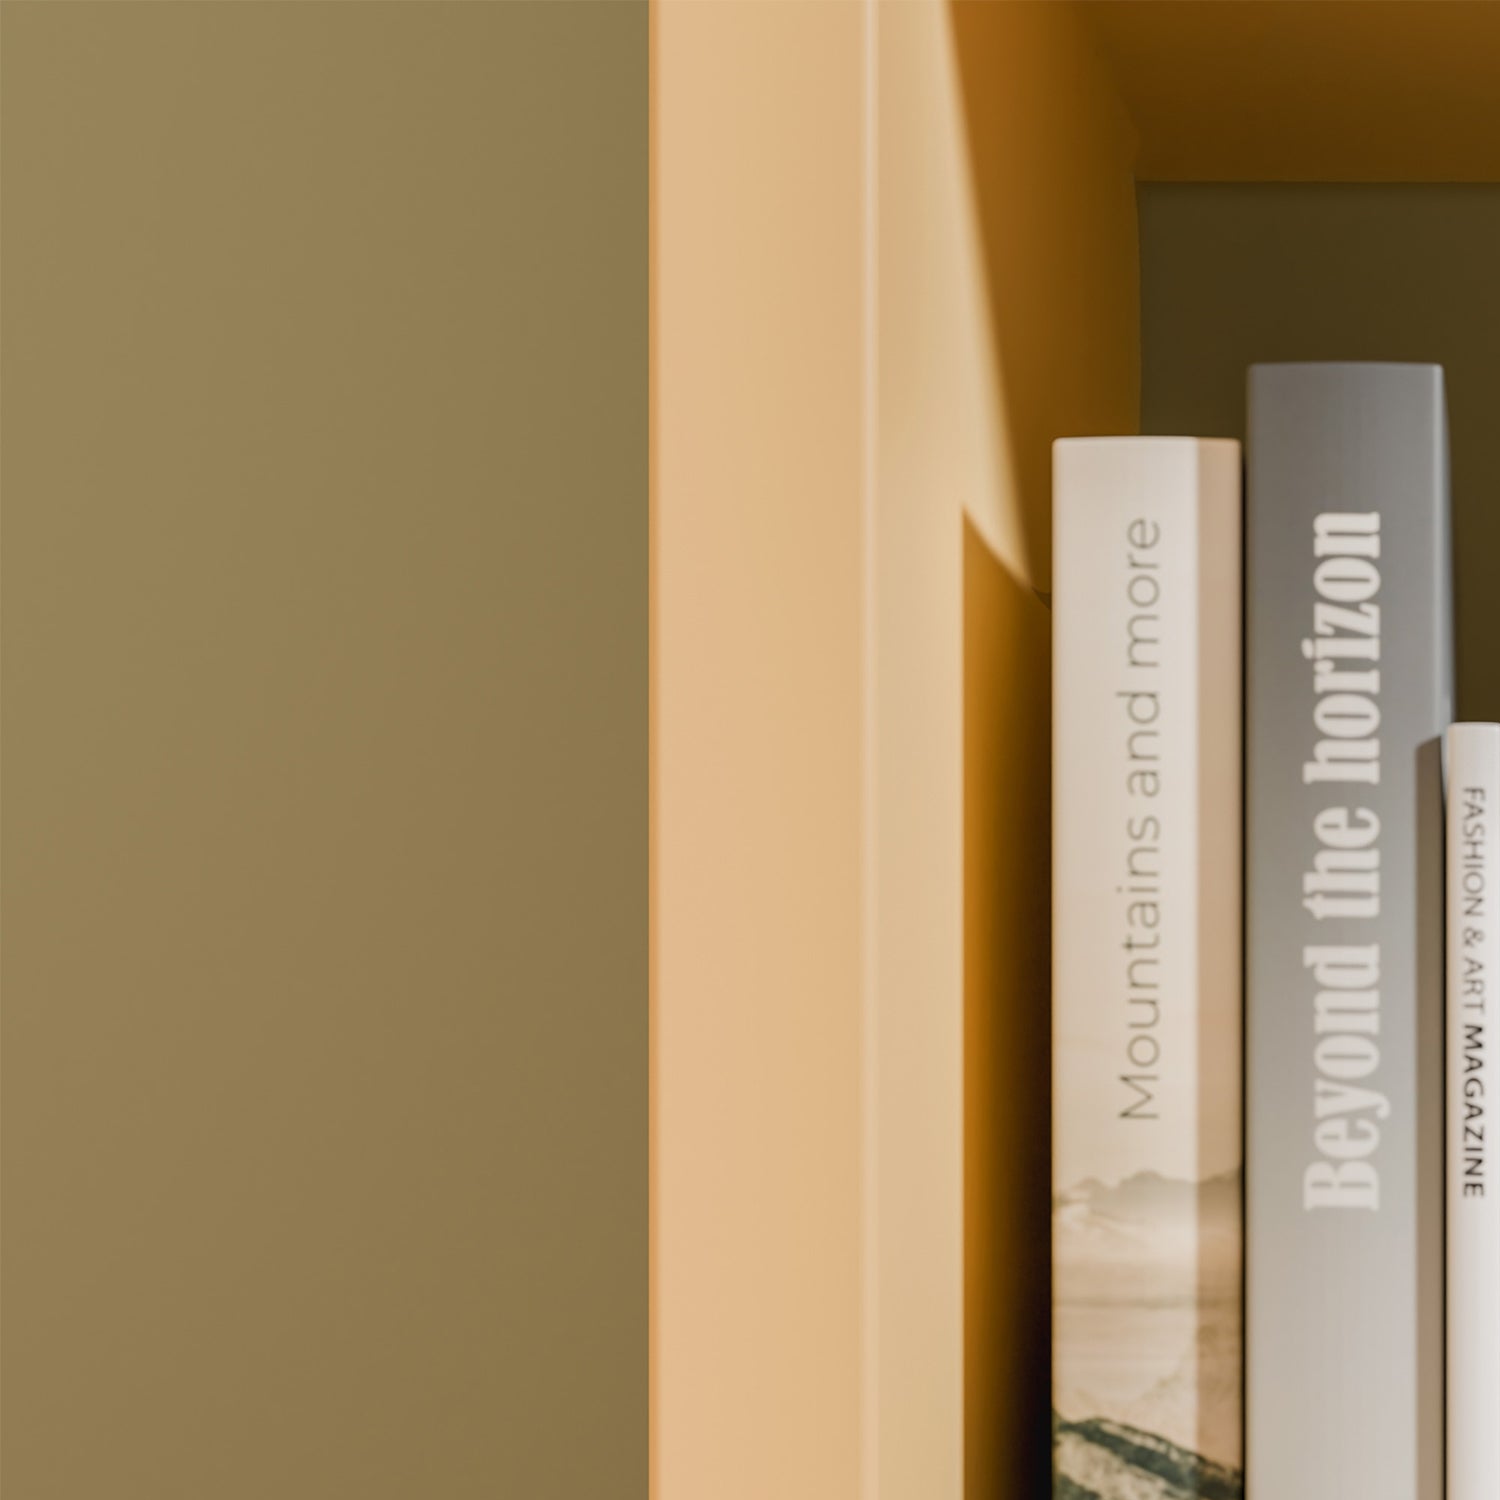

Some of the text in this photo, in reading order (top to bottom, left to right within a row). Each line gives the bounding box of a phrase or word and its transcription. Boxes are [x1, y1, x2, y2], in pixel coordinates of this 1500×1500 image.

[1116, 517, 1161, 1121] Mountains and more
[1301, 510, 1391, 1211] Beyond the horizon
[1462, 787, 1485, 1198] FASHION & ART MAGAZINE
